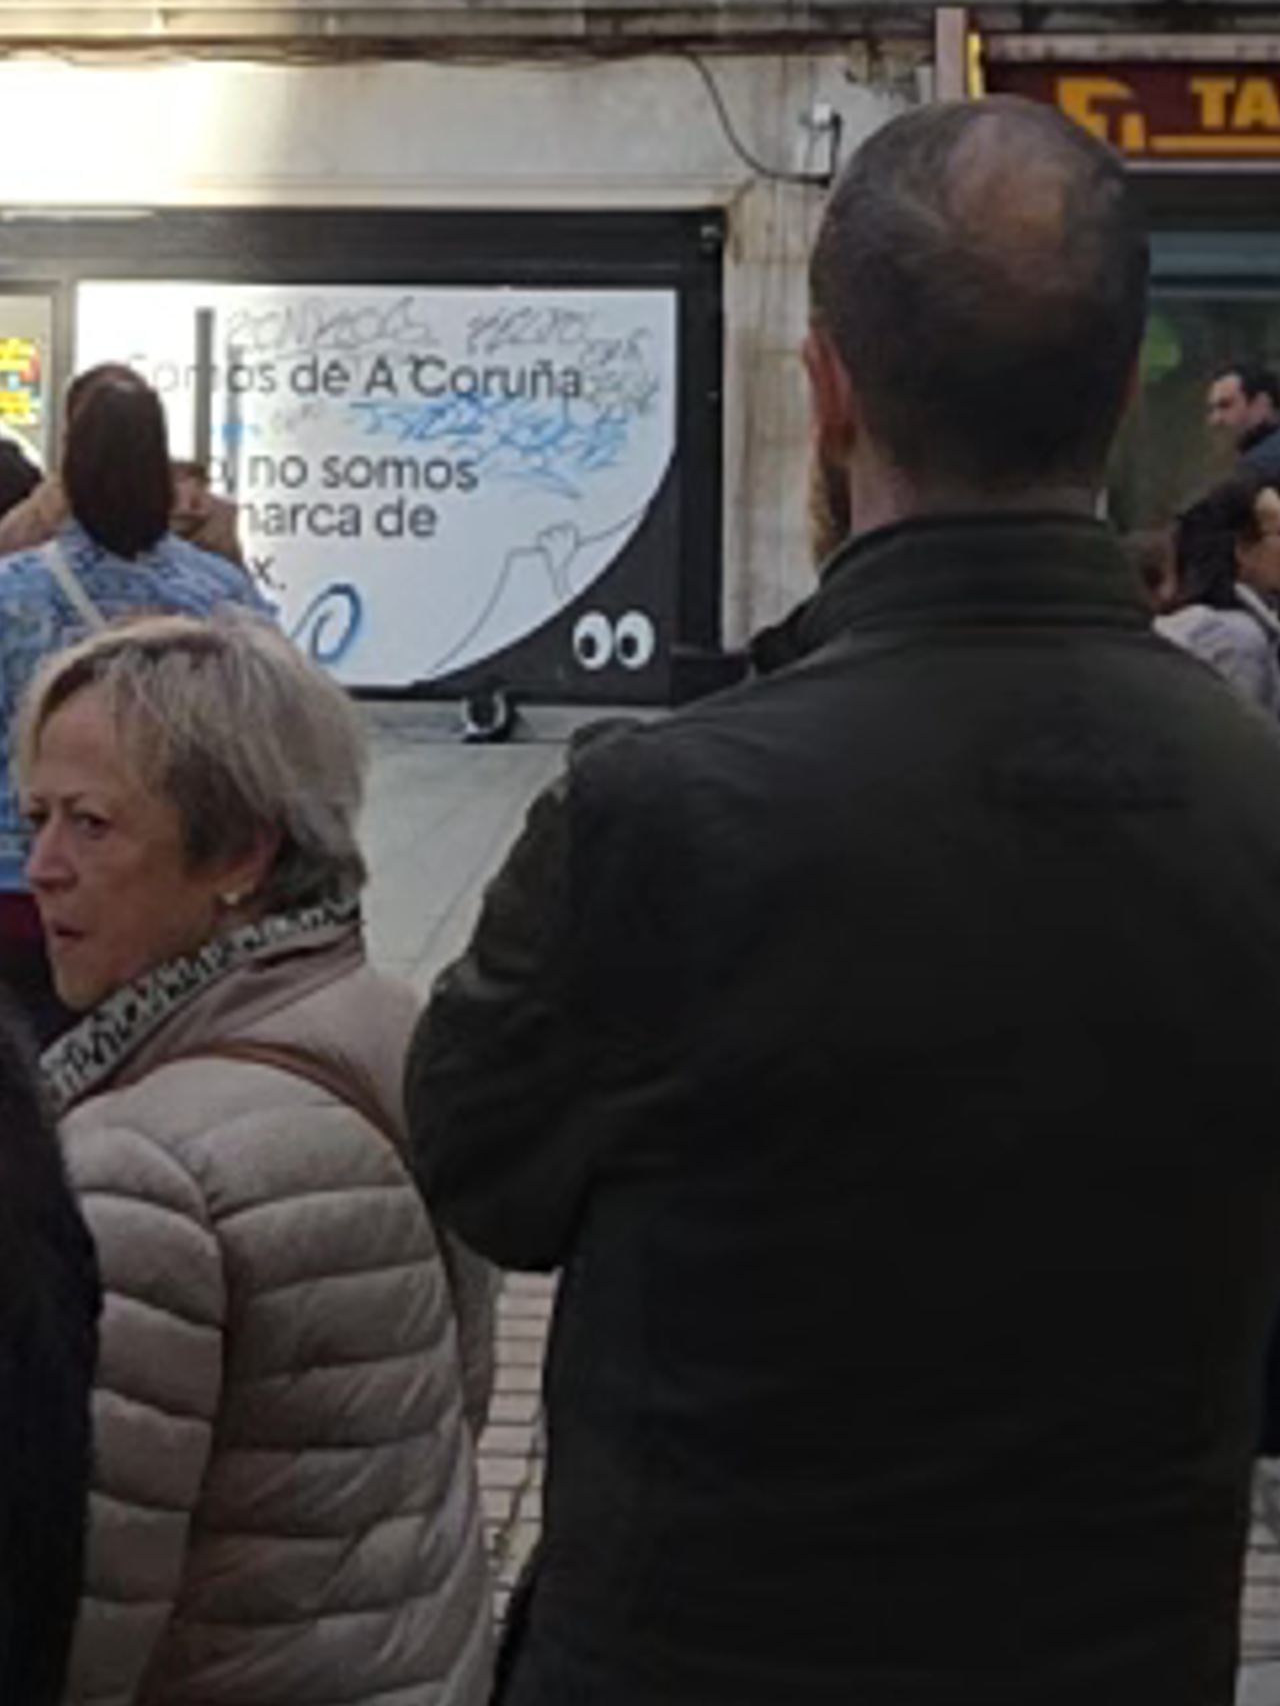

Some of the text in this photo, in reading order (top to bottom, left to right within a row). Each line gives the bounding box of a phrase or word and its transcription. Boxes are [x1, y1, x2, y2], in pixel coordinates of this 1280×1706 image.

[289, 357, 351, 399] de
[363, 357, 400, 397] A
[412, 356, 585, 400] Coruña
[246, 454, 309, 489] no
[321, 454, 481, 492] somos
[374, 496, 439, 540] de
